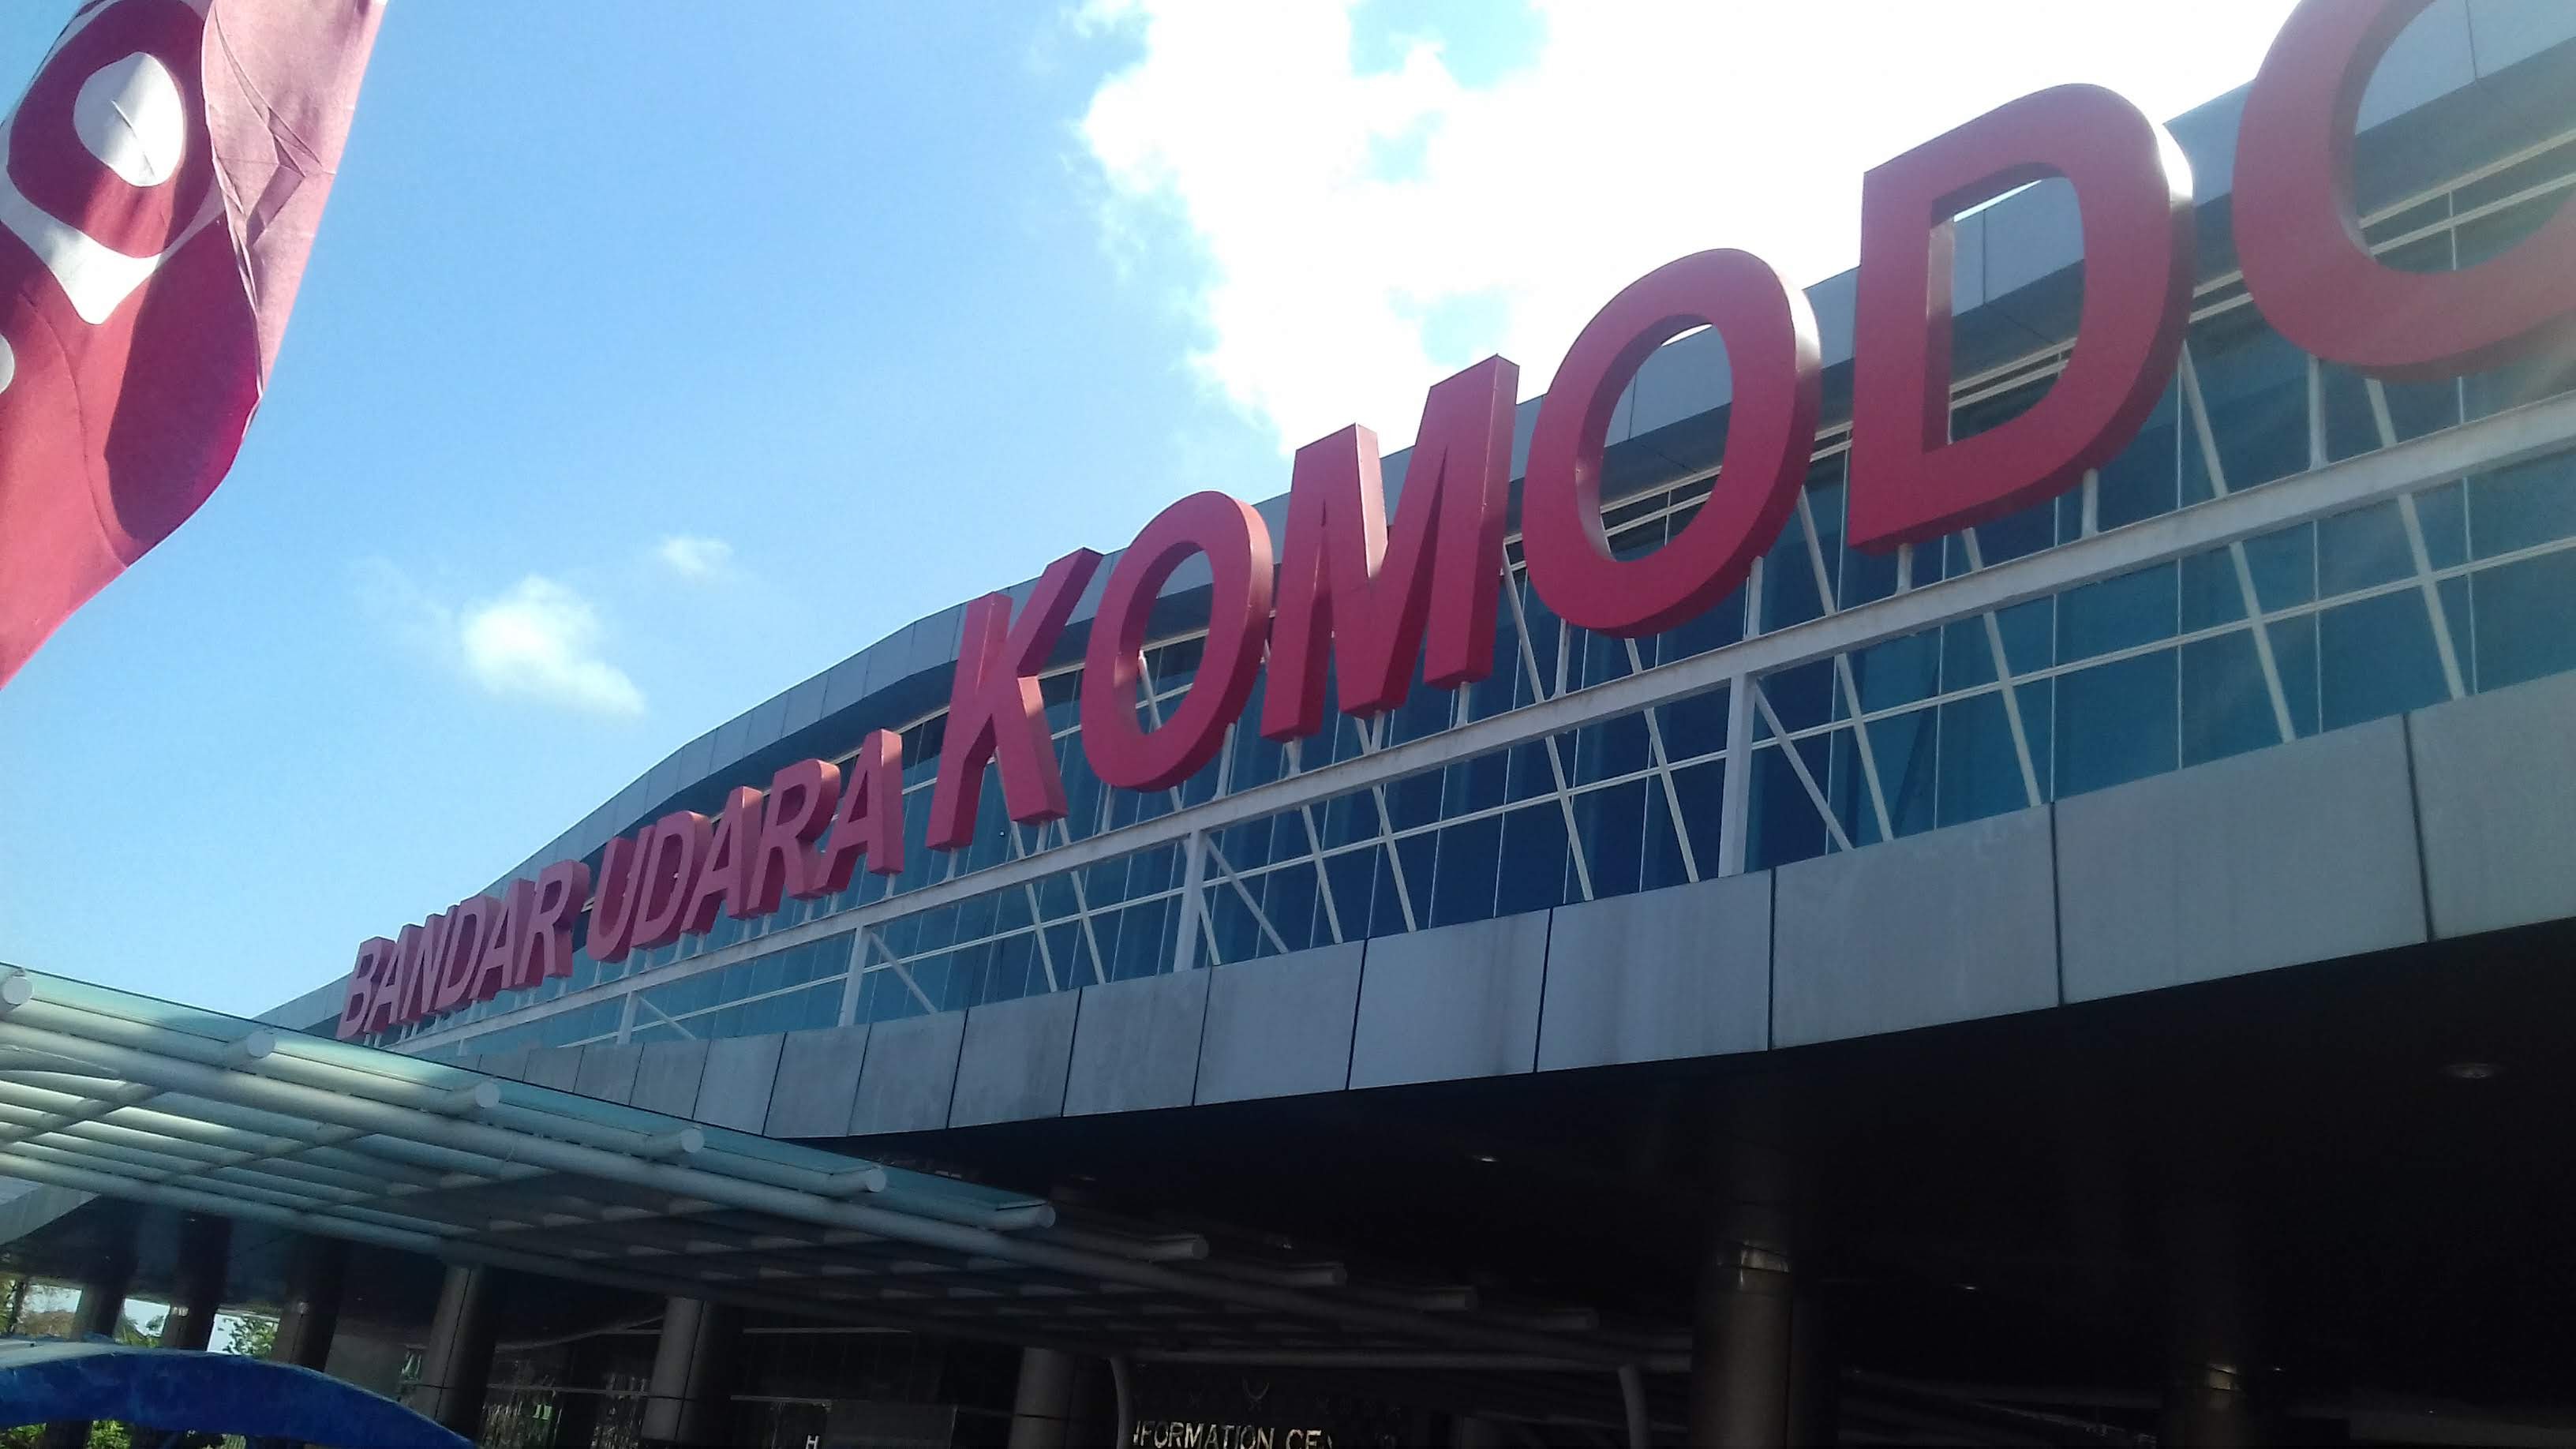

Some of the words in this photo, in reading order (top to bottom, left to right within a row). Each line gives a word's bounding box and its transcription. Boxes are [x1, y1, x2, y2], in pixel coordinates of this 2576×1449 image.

[337, 859, 590, 1039] BANDAR
[586, 728, 904, 964] UDARA
[928, 0, 2576, 849] KOMODO
